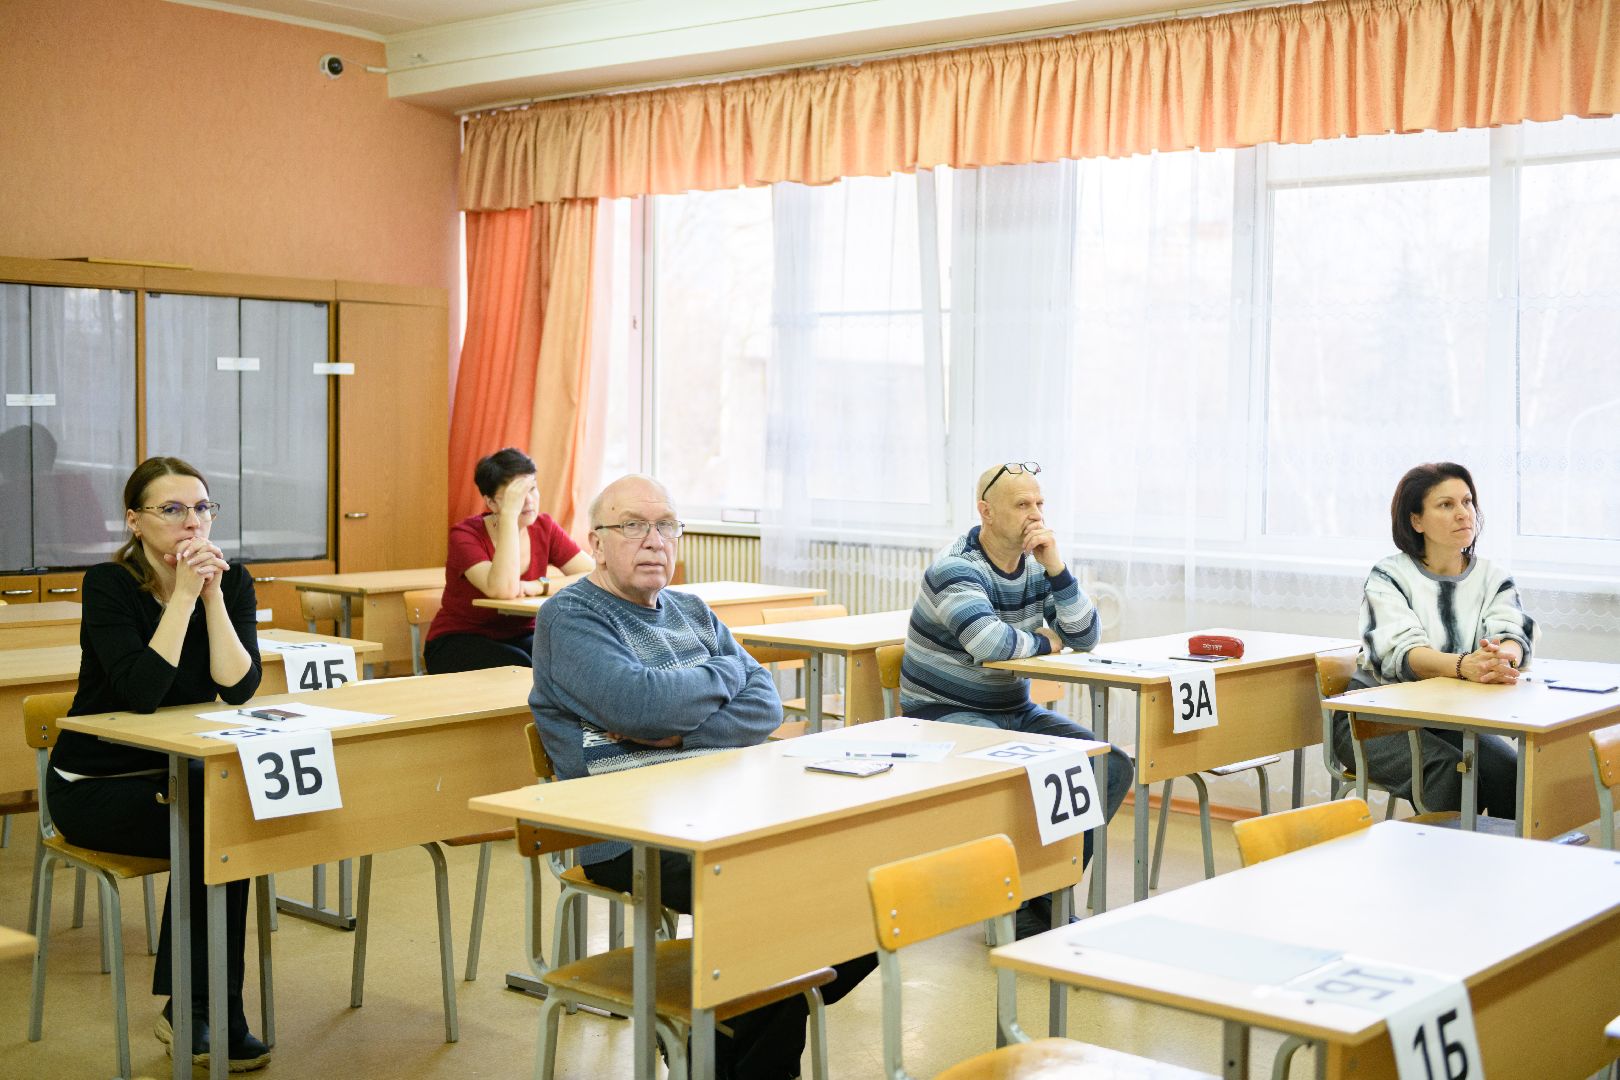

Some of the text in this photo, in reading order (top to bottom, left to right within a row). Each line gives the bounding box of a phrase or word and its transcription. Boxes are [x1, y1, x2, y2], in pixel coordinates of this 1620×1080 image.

[299, 659, 348, 691] 4Б
[1179, 680, 1213, 720] 3А
[257, 747, 323, 800] 3Б
[1044, 765, 1091, 825] 2Б
[1412, 1008, 1469, 1080] 1Б
